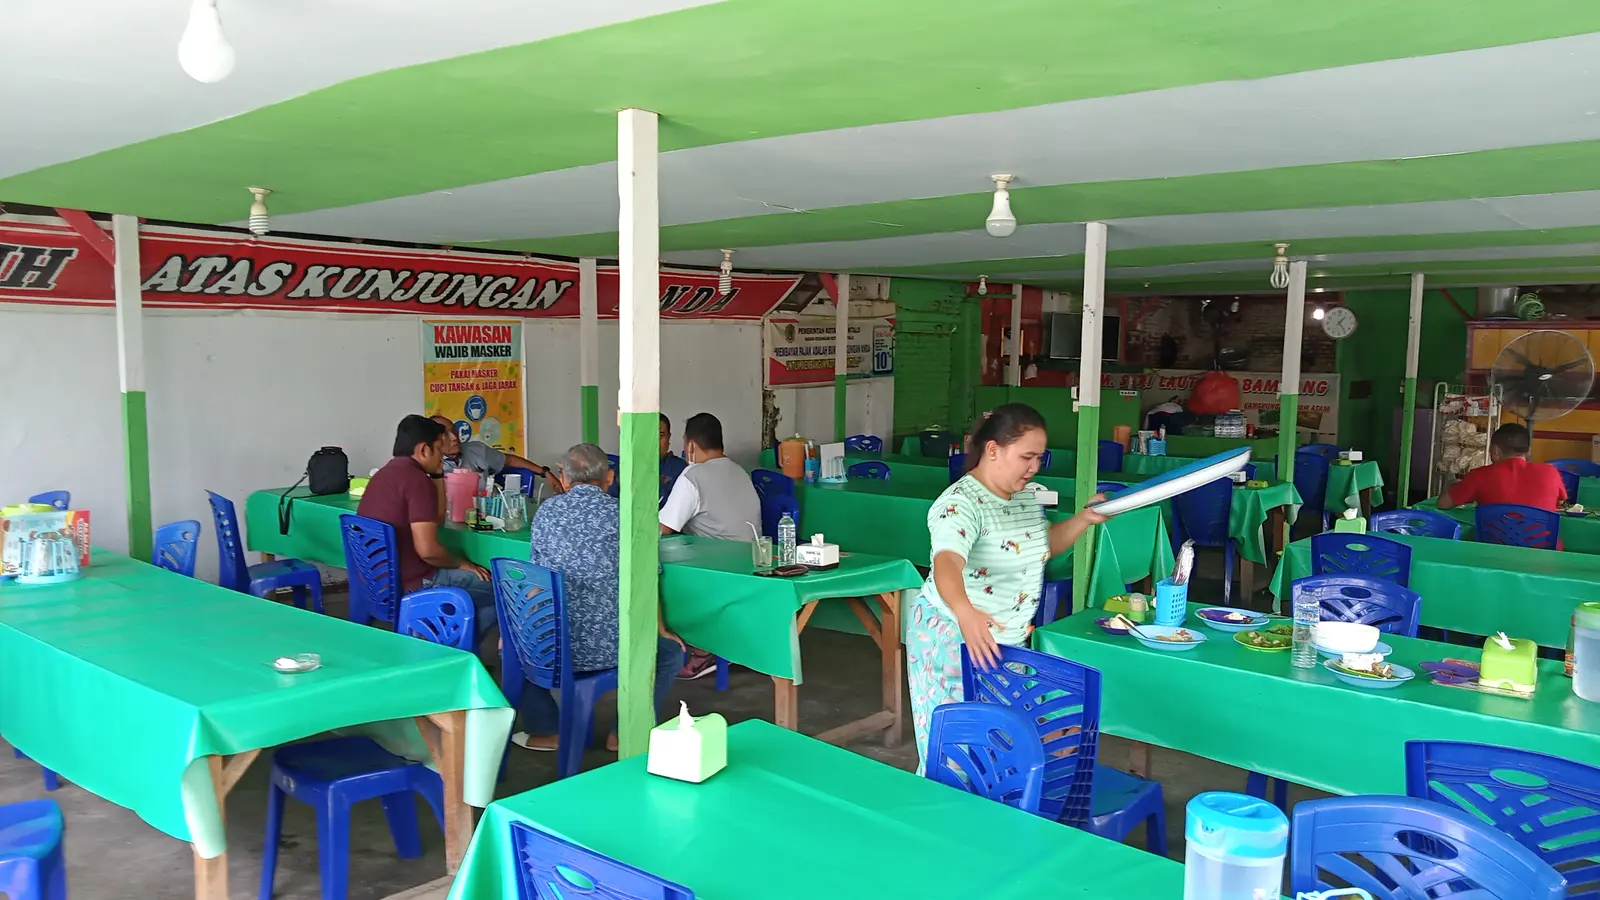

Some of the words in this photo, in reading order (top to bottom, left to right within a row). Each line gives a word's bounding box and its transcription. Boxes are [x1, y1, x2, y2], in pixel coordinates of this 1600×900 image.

[142, 252, 293, 298] ATAS
[286, 264, 574, 311] KUNJUNGAN
[434, 325, 512, 344] KAWASAN
[435, 345, 468, 359] WAJIB
[471, 345, 512, 358] MASKER
[450, 370, 470, 379] PAKAI
[472, 369, 498, 379] MASKER
[430, 383, 447, 393] CUCI
[448, 382, 475, 392] TANGAN
[482, 382, 497, 391] JAGA
[498, 380, 517, 390] JARAK
[1242, 377, 1329, 396] BAMNG
[1310, 405, 1330, 413] ASAM
